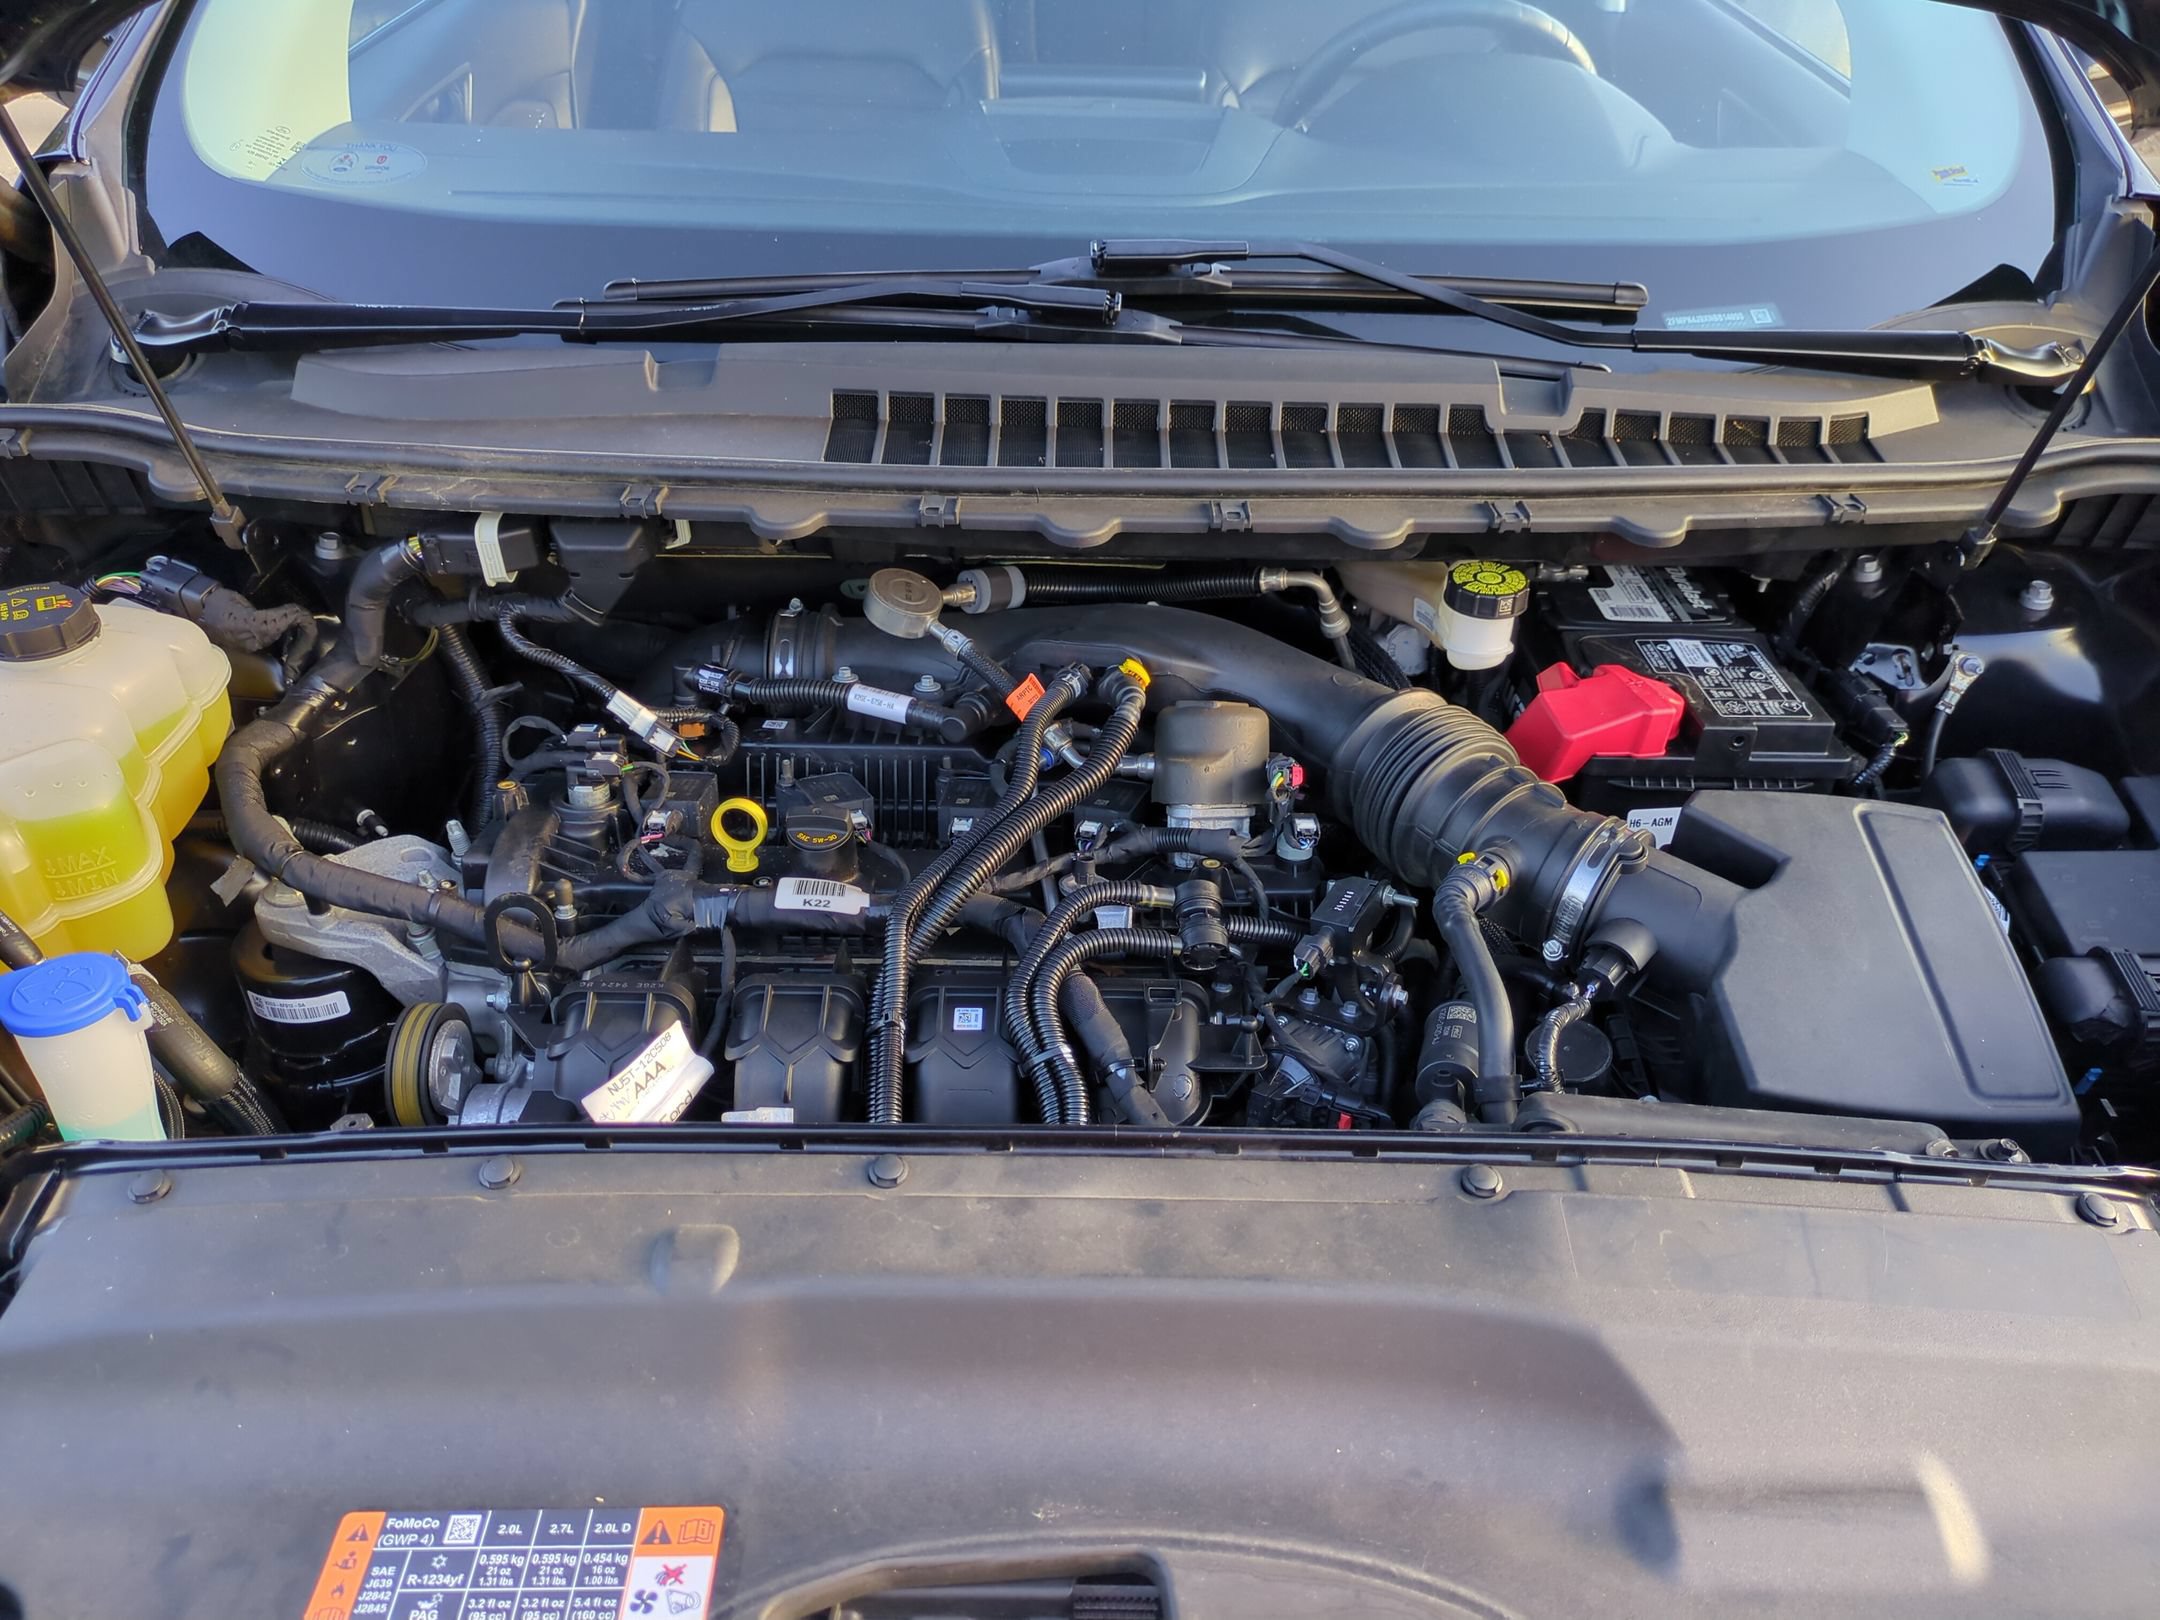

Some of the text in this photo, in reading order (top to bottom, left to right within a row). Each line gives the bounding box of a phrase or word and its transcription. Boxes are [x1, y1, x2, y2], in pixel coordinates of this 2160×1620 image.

[812, 834, 838, 843] 5W-30
[57, 846, 112, 873] MAX
[66, 868, 120, 896] MIN
[803, 898, 831, 908] K22
[634, 1060, 667, 1099] AAA
[387, 1518, 440, 1529] FoMoCo
[594, 1523, 631, 1534] 2.0L D
[497, 1524, 523, 1534] 2.0L
[549, 1524, 574, 1534] 2.7L
[377, 1533, 435, 1547] (GWP 4)
[479, 1554, 525, 1567] 0.595 kg
[531, 1554, 577, 1567] 0.595 kg
[583, 1553, 628, 1566] 0.454 kg
[371, 1567, 396, 1576] SAE
[486, 1566, 511, 1576] 21 oz
[539, 1566, 564, 1576] 21 oz
[592, 1566, 615, 1575] 16 oz
[365, 1579, 393, 1588] J639
[407, 1574, 465, 1587] R-1234yf
[479, 1577, 514, 1586] 1.31 lbs
[531, 1577, 566, 1586] 1.31 lbs
[584, 1576, 618, 1585] 1.00 lbs
[358, 1591, 392, 1601] J2842
[468, 1598, 511, 1609] 3.2 fl oz
[521, 1598, 565, 1608] 3.2 fl oz
[573, 1597, 617, 1608] 5.4 fl oz
[353, 1604, 387, 1614] J2845
[409, 1610, 438, 1620] PAG
[468, 1612, 506, 1620] (95 cc)
[522, 1611, 560, 1620] (95 cc)
[572, 1611, 616, 1620] (160 cc)
